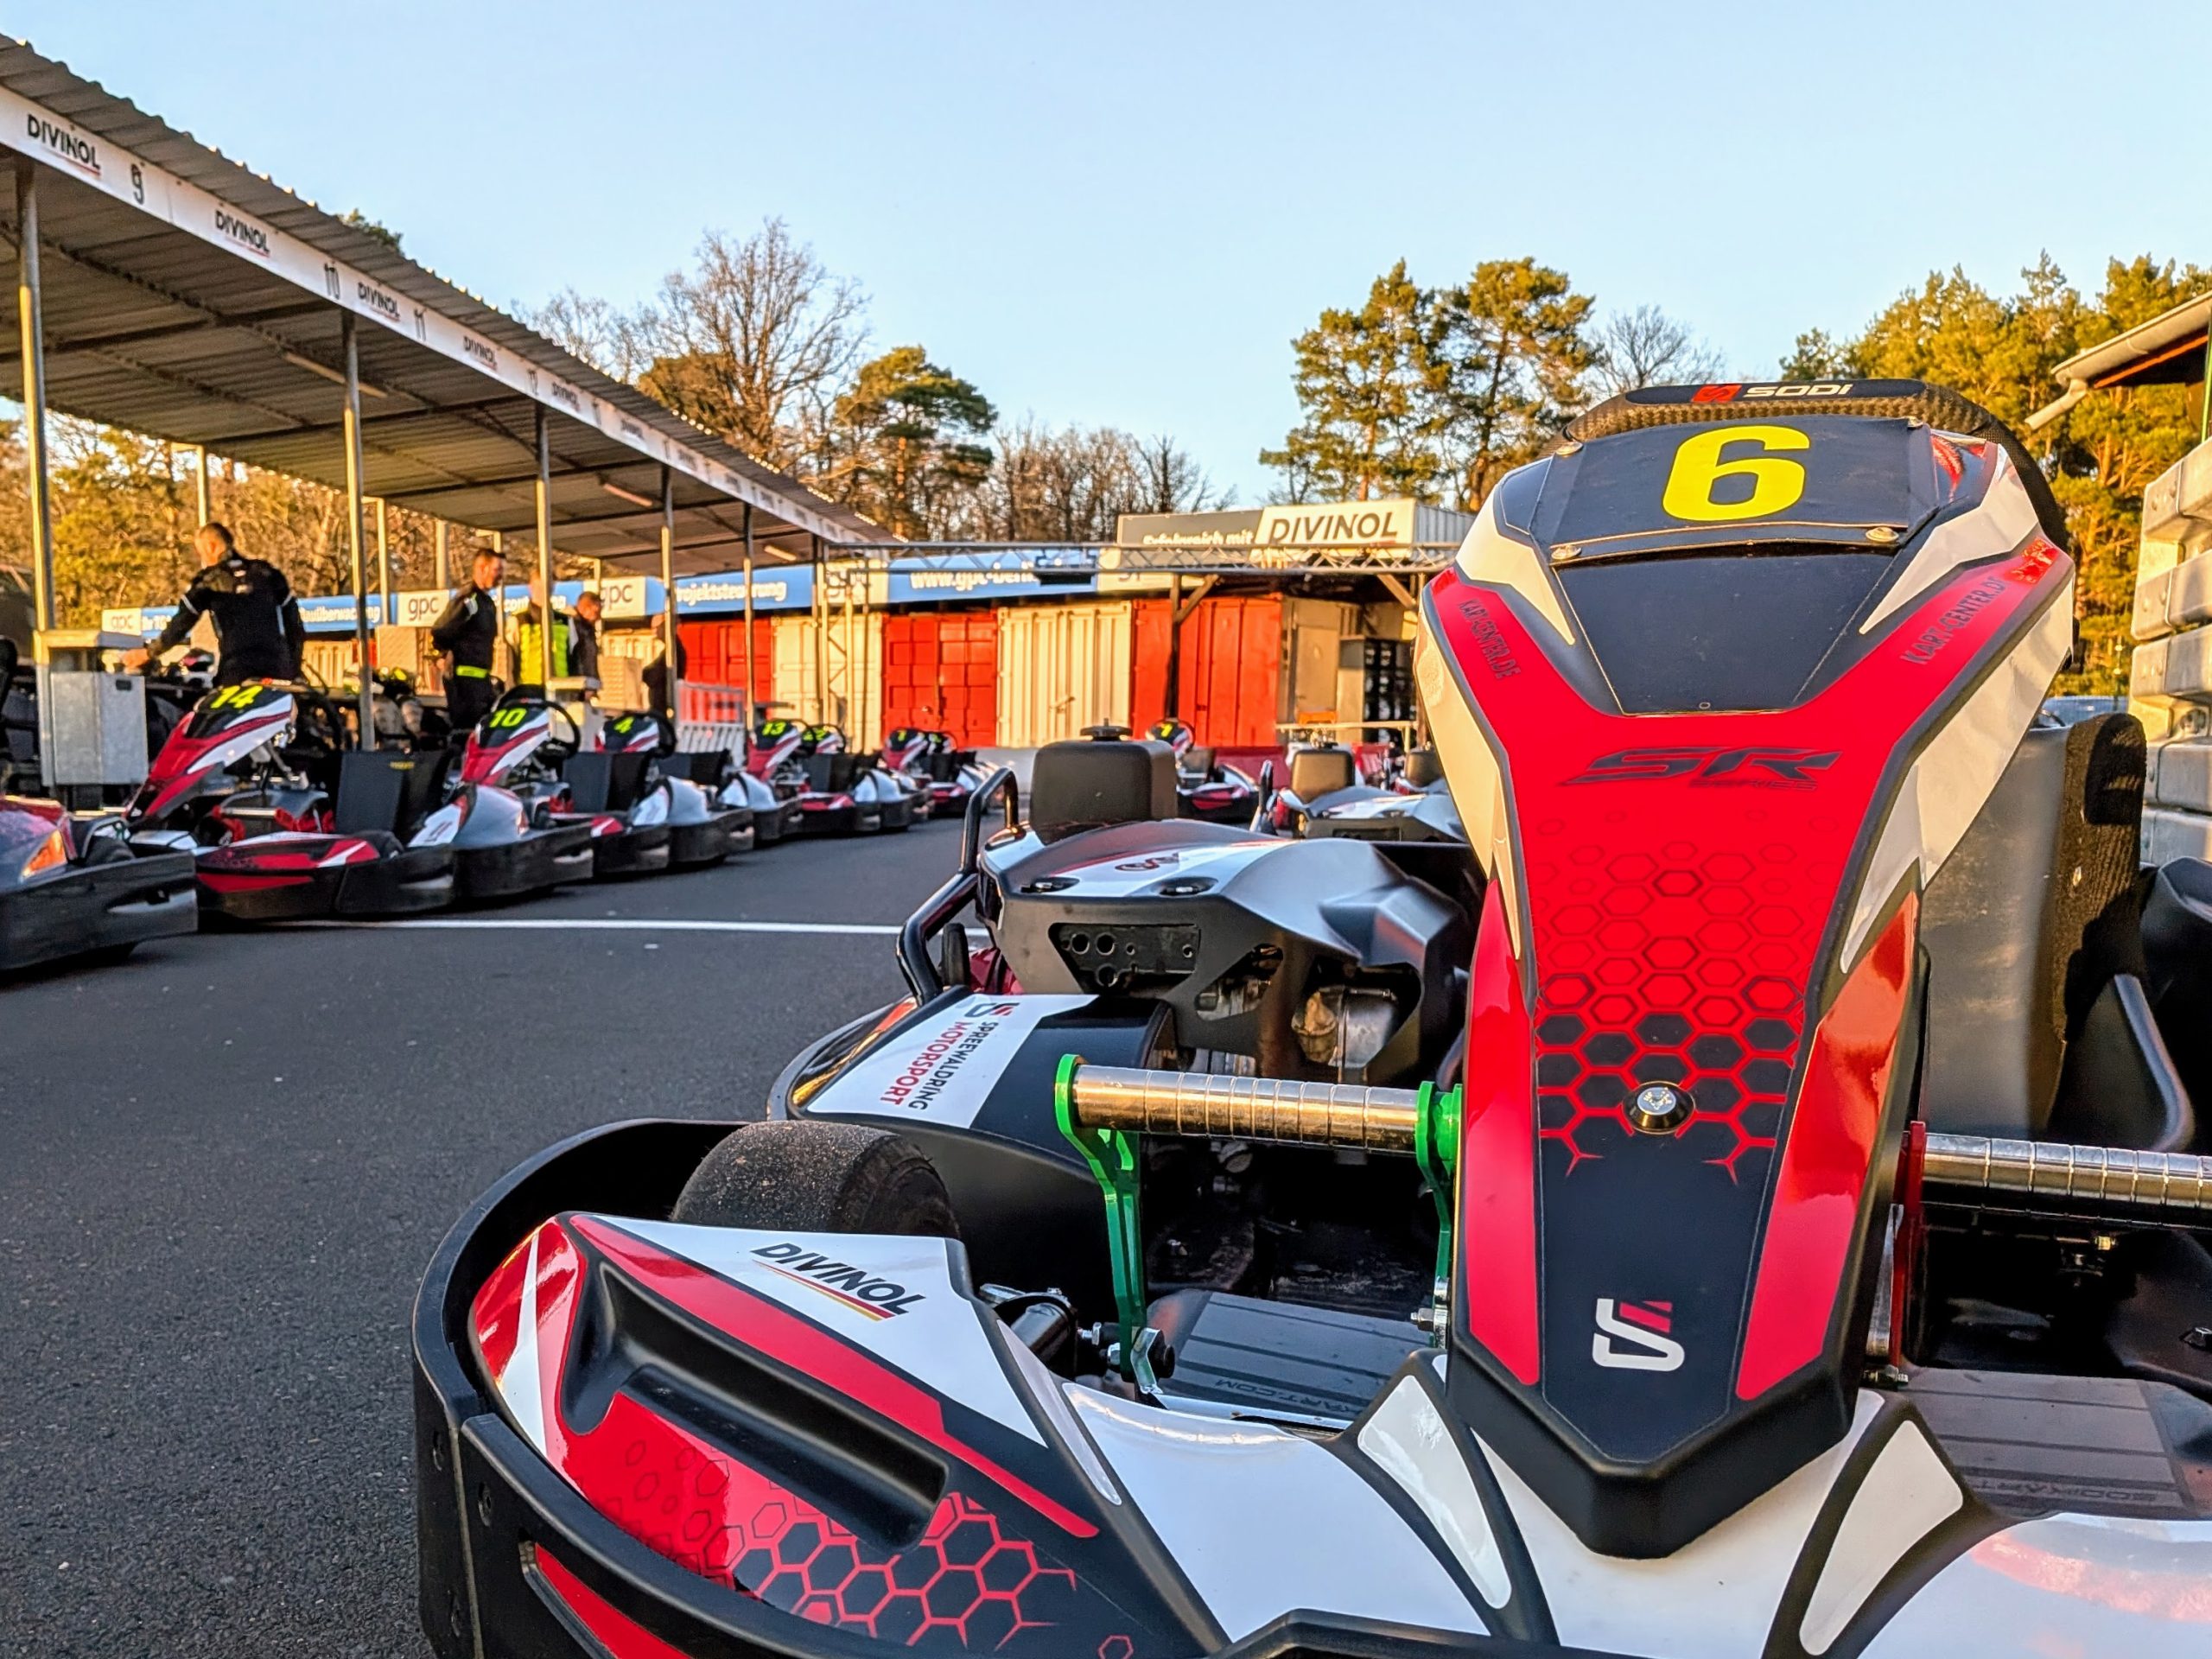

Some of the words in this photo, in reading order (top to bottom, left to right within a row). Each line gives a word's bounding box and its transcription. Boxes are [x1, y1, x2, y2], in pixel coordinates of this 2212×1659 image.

[28, 114, 101, 171] DIVINOL
[130, 164, 145, 205] 9
[215, 209, 270, 253] DIVINOL
[324, 263, 340, 300] 10
[358, 281, 400, 318] DIVINOL
[1743, 384, 1853, 398] SODI
[1662, 424, 1810, 521] 6
[1225, 528, 1254, 545] mit
[1269, 512, 1398, 544] DIVINOL
[408, 595, 440, 621] gpc
[210, 685, 263, 709] 14
[489, 708, 527, 728] 10
[614, 716, 635, 734] 4
[761, 721, 786, 735] 13
[1559, 747, 1843, 785] SR
[880, 1021, 975, 1106] MOTORSPORT
[908, 1021, 999, 1110] SPREEWALDRING
[750, 1243, 926, 1315] DIVINOL
